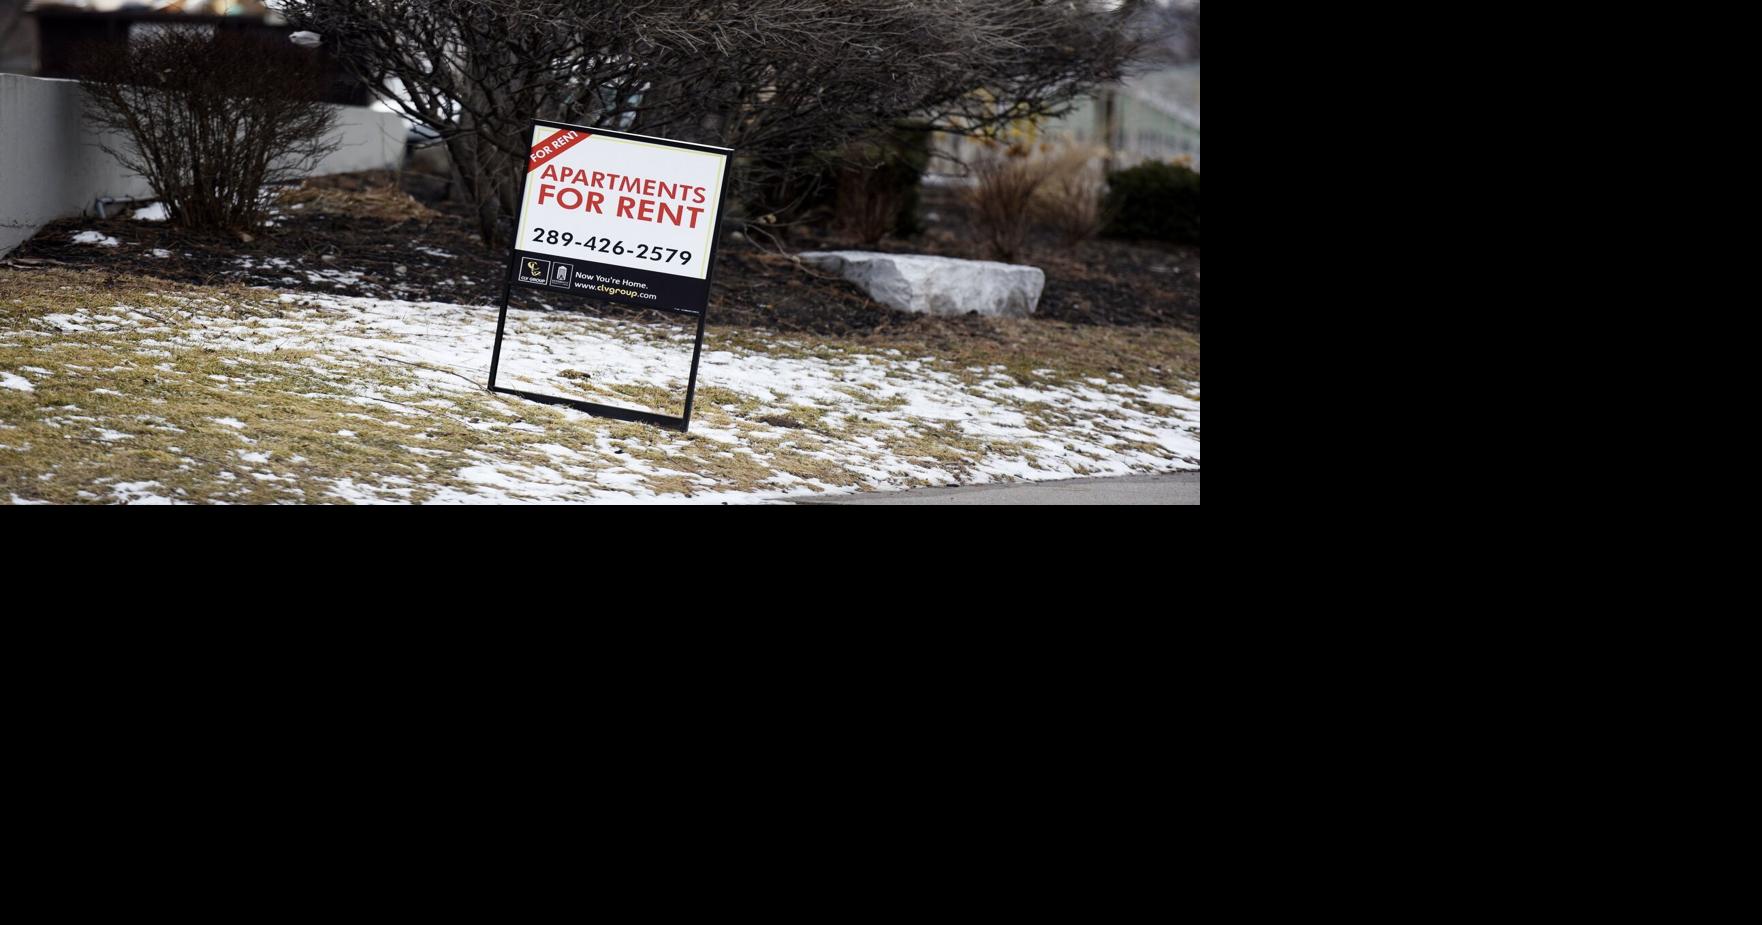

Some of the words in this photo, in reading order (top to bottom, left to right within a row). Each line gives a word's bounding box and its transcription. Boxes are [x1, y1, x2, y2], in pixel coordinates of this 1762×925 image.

[530, 145, 553, 162] FOR
[540, 164, 706, 204] APARTMENTS
[537, 183, 605, 215] FOR
[616, 196, 705, 229] RENT
[532, 227, 692, 266] 289-426-2579
[574, 281, 657, 300] www.clvgroup.com
[575, 271, 594, 280] Now
[596, 274, 621, 285] You're
[622, 279, 648, 290] Home.
